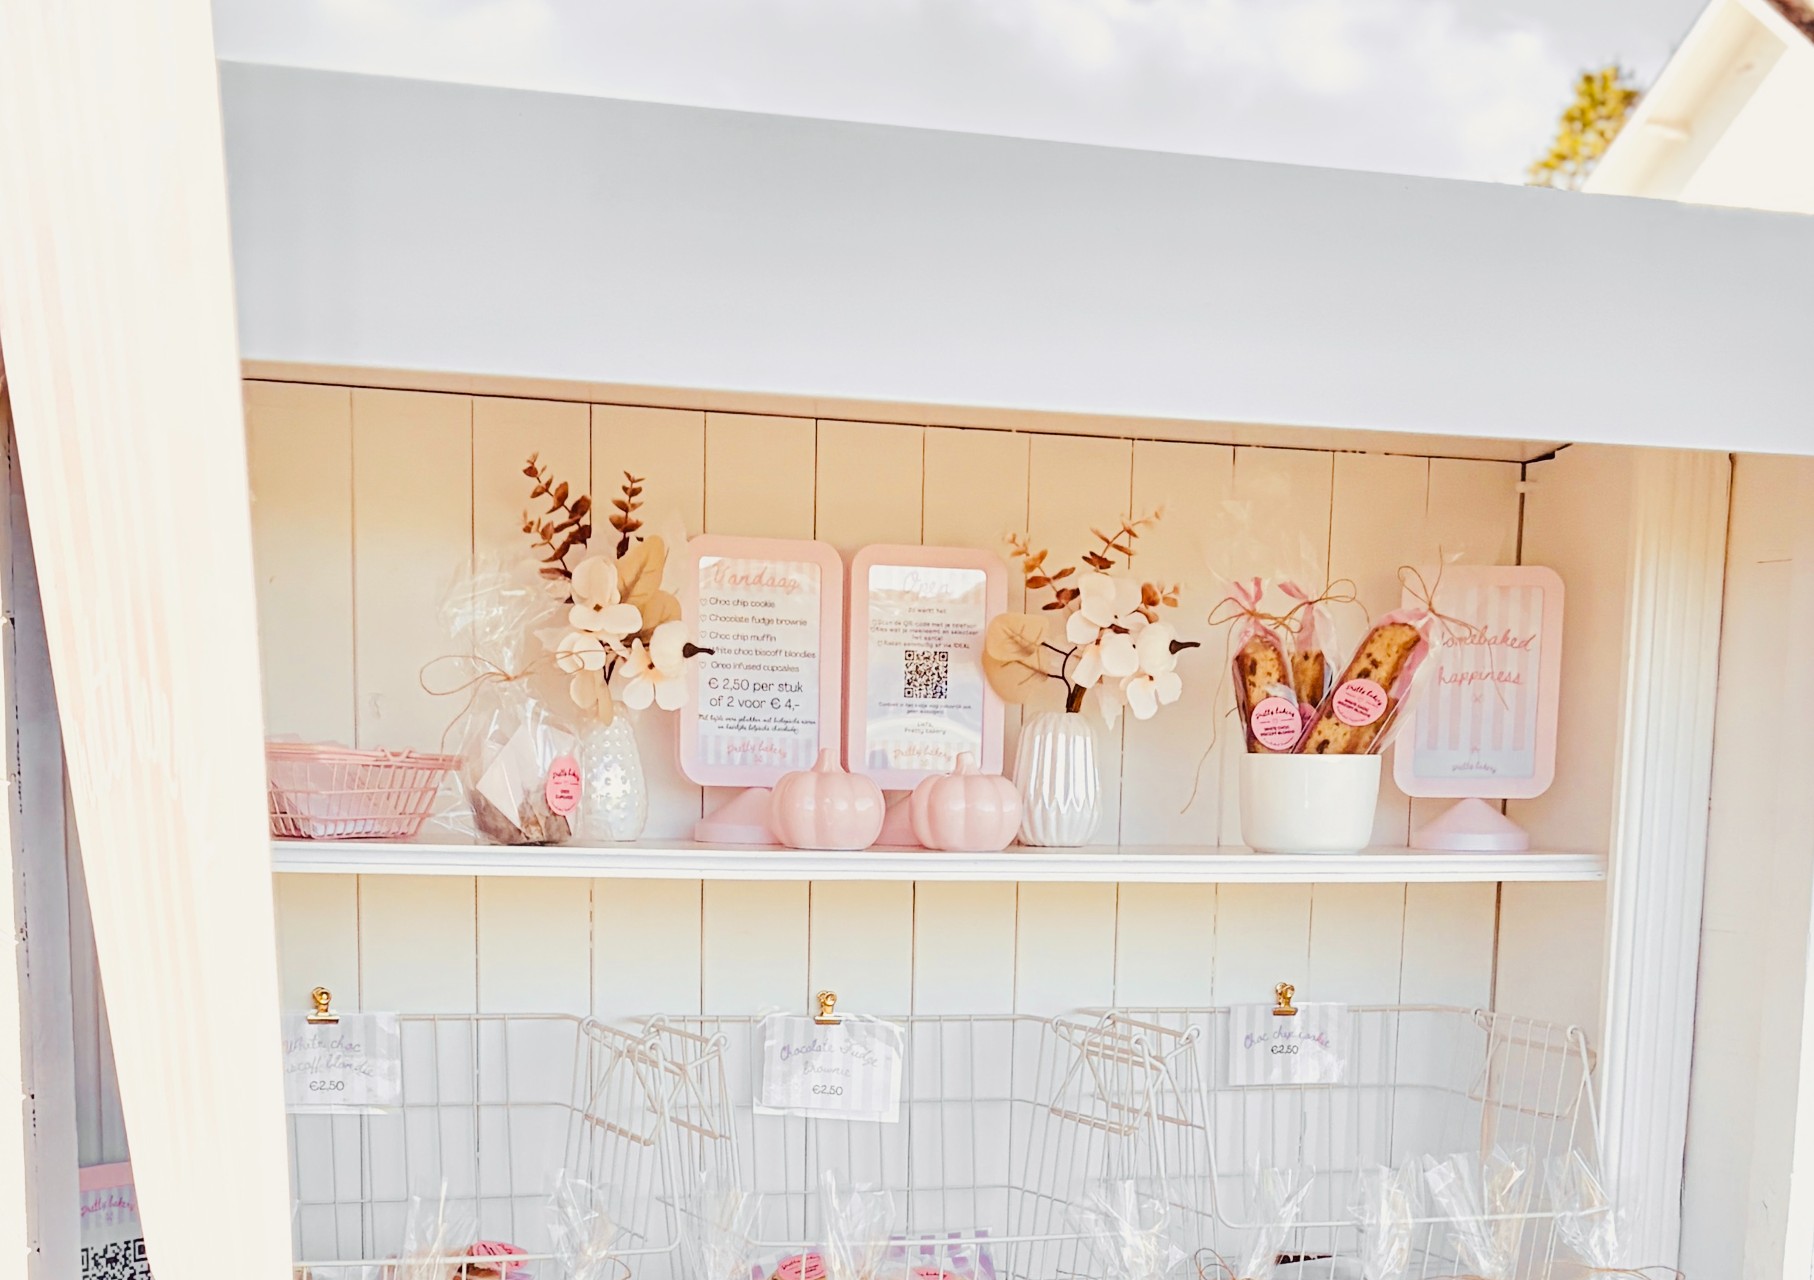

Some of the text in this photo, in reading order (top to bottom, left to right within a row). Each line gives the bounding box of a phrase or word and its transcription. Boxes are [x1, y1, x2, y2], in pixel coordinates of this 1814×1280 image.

[713, 563, 800, 595] Vandaag
[709, 597, 775, 608] Choc chip cookie
[709, 614, 807, 626] Chocolate fudge brownie
[709, 632, 776, 642] Choc chip muffin
[734, 647, 753, 655] choc
[755, 647, 782, 656] biscoff
[784, 649, 816, 658] blondies
[711, 661, 800, 673] Oreo infused cupcakes
[1438, 666, 1522, 687] happiness
[708, 677, 803, 693] € 2,50 per stuk
[709, 695, 723, 708] of
[727, 696, 734, 708] 2
[738, 698, 766, 708] voor
[770, 697, 781, 710] €
[780, 1039, 836, 1062] Chocolate
